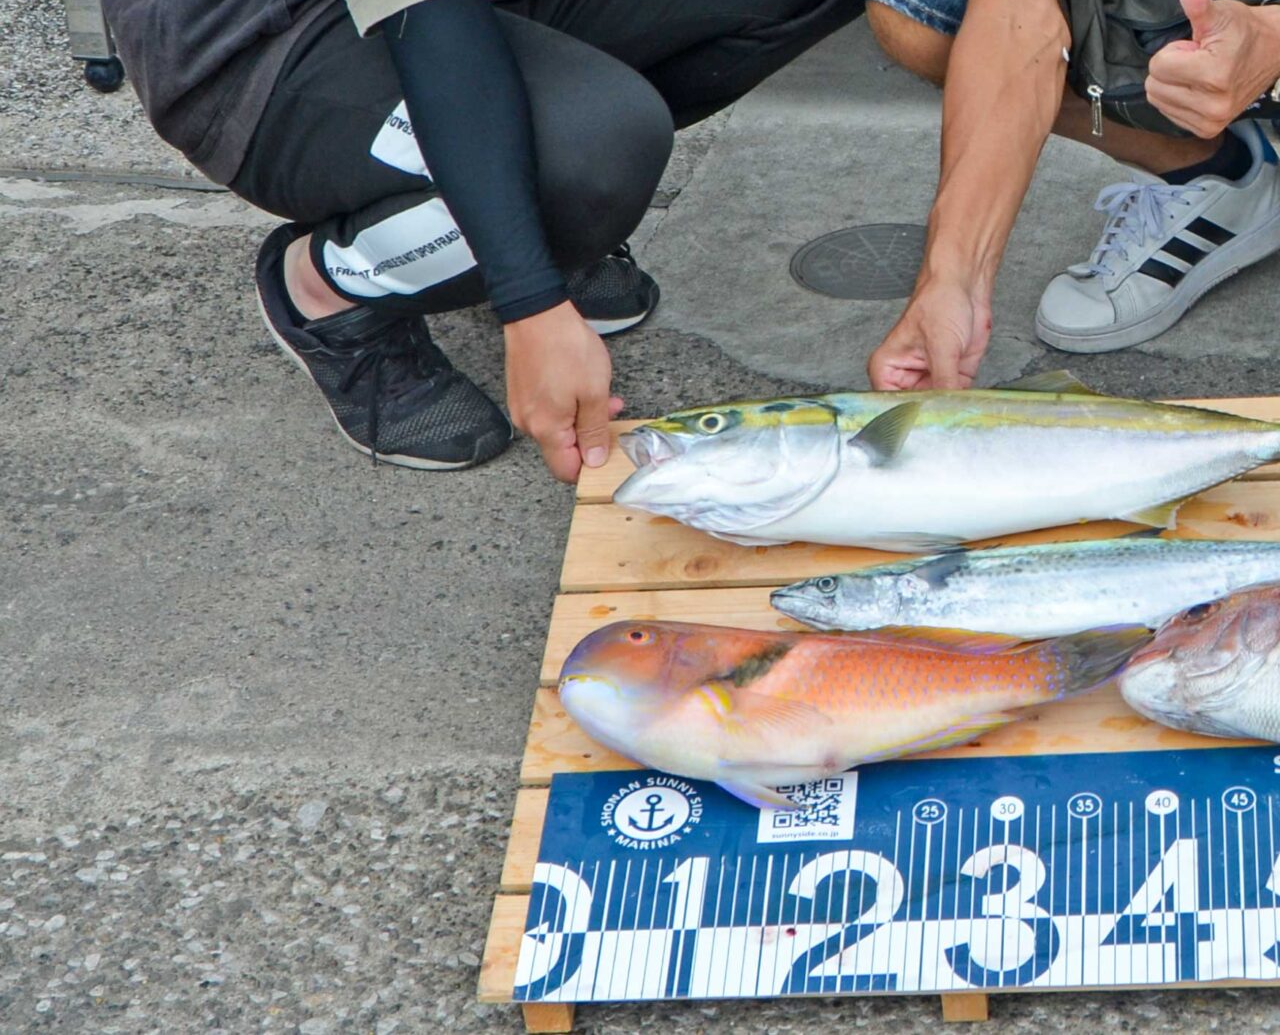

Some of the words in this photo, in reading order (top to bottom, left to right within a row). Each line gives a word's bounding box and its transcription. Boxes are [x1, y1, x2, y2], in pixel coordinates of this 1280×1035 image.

[600, 780, 641, 827] SHONAN
[646, 776, 697, 797] SUNNY
[688, 795, 704, 825] SIDE
[921, 806, 938, 818] 25
[999, 803, 1016, 815] 30
[1076, 799, 1094, 812] 35
[1154, 797, 1171, 809] 40
[1231, 793, 1248, 806] 45
[614, 833, 682, 851] MARINA
[663, 857, 709, 998] 1
[780, 850, 905, 994] 2
[944, 844, 1060, 988] 3
[1100, 839, 1215, 982] 4
